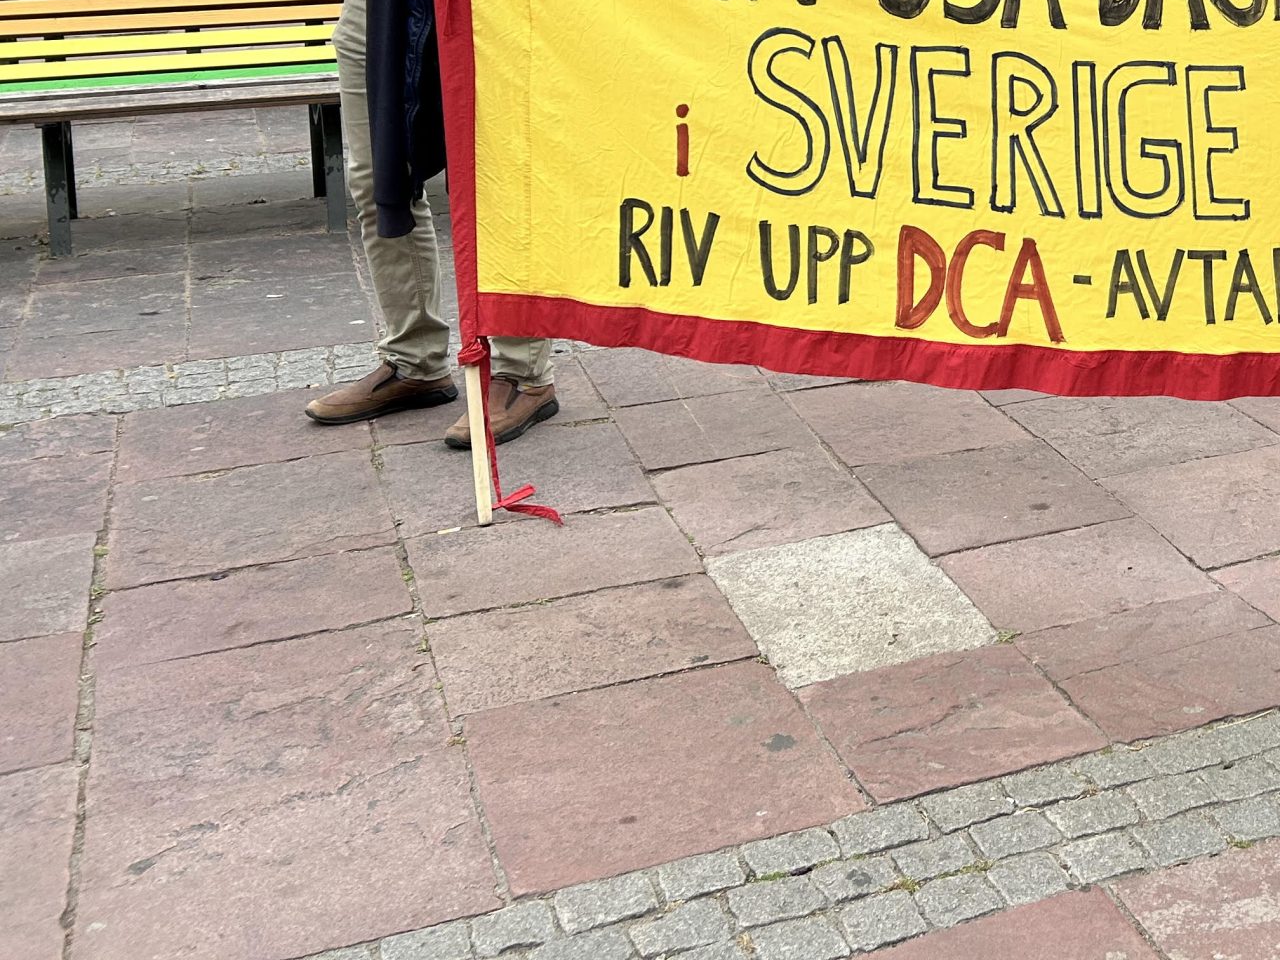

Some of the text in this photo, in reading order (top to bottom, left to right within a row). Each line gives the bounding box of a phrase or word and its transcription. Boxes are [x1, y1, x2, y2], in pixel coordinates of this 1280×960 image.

[675, 27, 1251, 221] i SVERIGE
[618, 198, 720, 288] RIV
[758, 219, 874, 305] UPP
